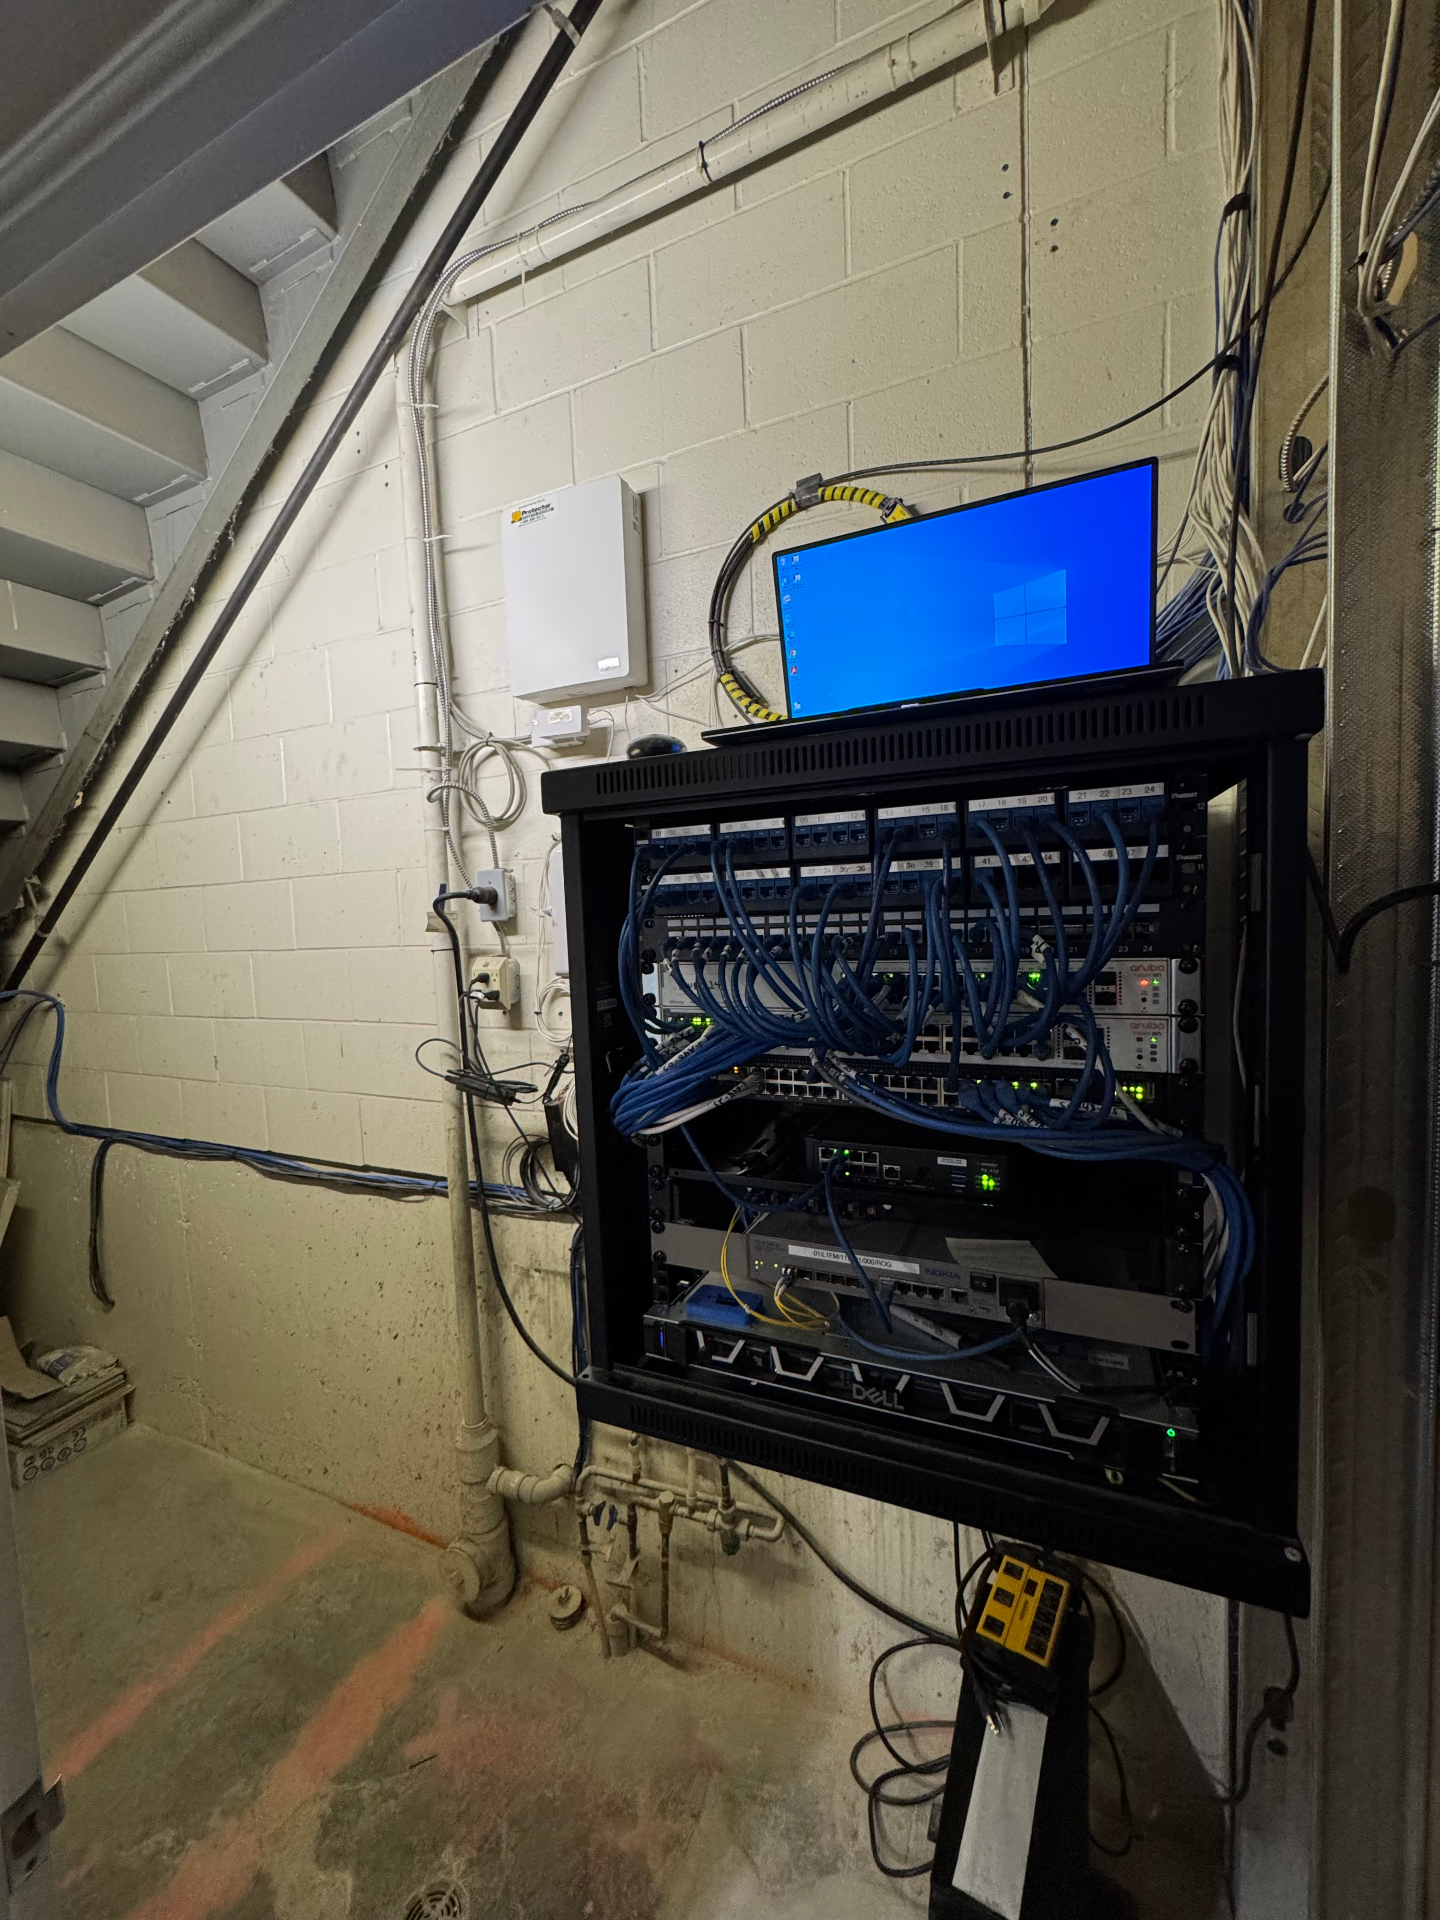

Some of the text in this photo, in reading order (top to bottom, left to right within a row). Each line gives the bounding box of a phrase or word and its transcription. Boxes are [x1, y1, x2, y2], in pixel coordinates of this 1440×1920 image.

[521, 503, 552, 516] Protector
[1077, 792, 1087, 800] 21
[1099, 790, 1110, 798] 22
[1144, 786, 1155, 794] 24
[922, 806, 931, 814] 15
[1197, 802, 1206, 810] 12
[1102, 850, 1114, 858] 46
[1118, 945, 1129, 953] 23
[1130, 964, 1166, 972] aruba
[1130, 1022, 1165, 1030] aruba
[1193, 1211, 1200, 1220] 5
[924, 1267, 961, 1280] NOKIA
[1191, 1377, 1198, 1386] 2
[852, 1383, 905, 1410] DELL
